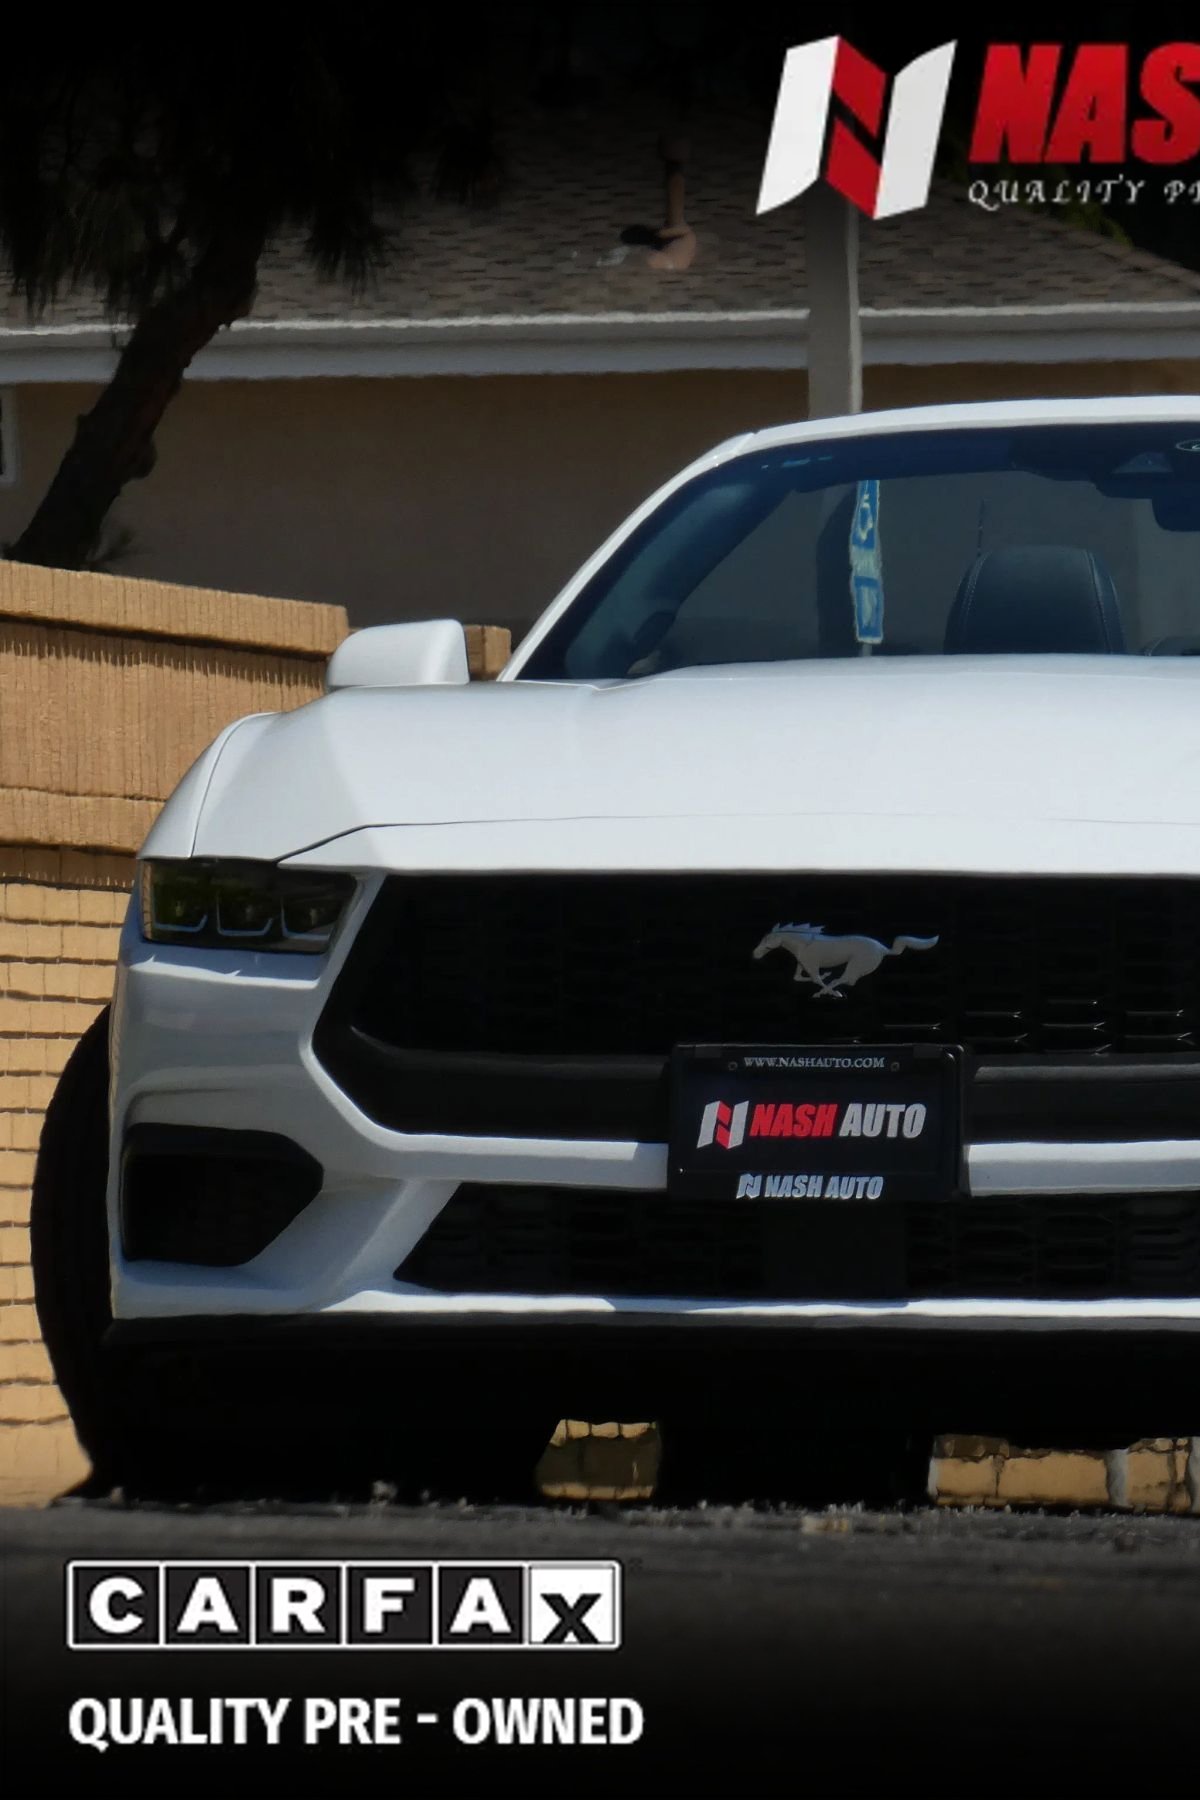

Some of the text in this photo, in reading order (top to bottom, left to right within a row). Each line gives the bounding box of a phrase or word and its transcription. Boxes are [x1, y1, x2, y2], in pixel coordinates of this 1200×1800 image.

[743, 1056, 885, 1069] WWW.NASHAUTO.COM
[748, 1101, 838, 1138] NASH
[838, 1102, 927, 1139] AUTO
[764, 1174, 824, 1199] NASH
[823, 1175, 885, 1201] AUTO
